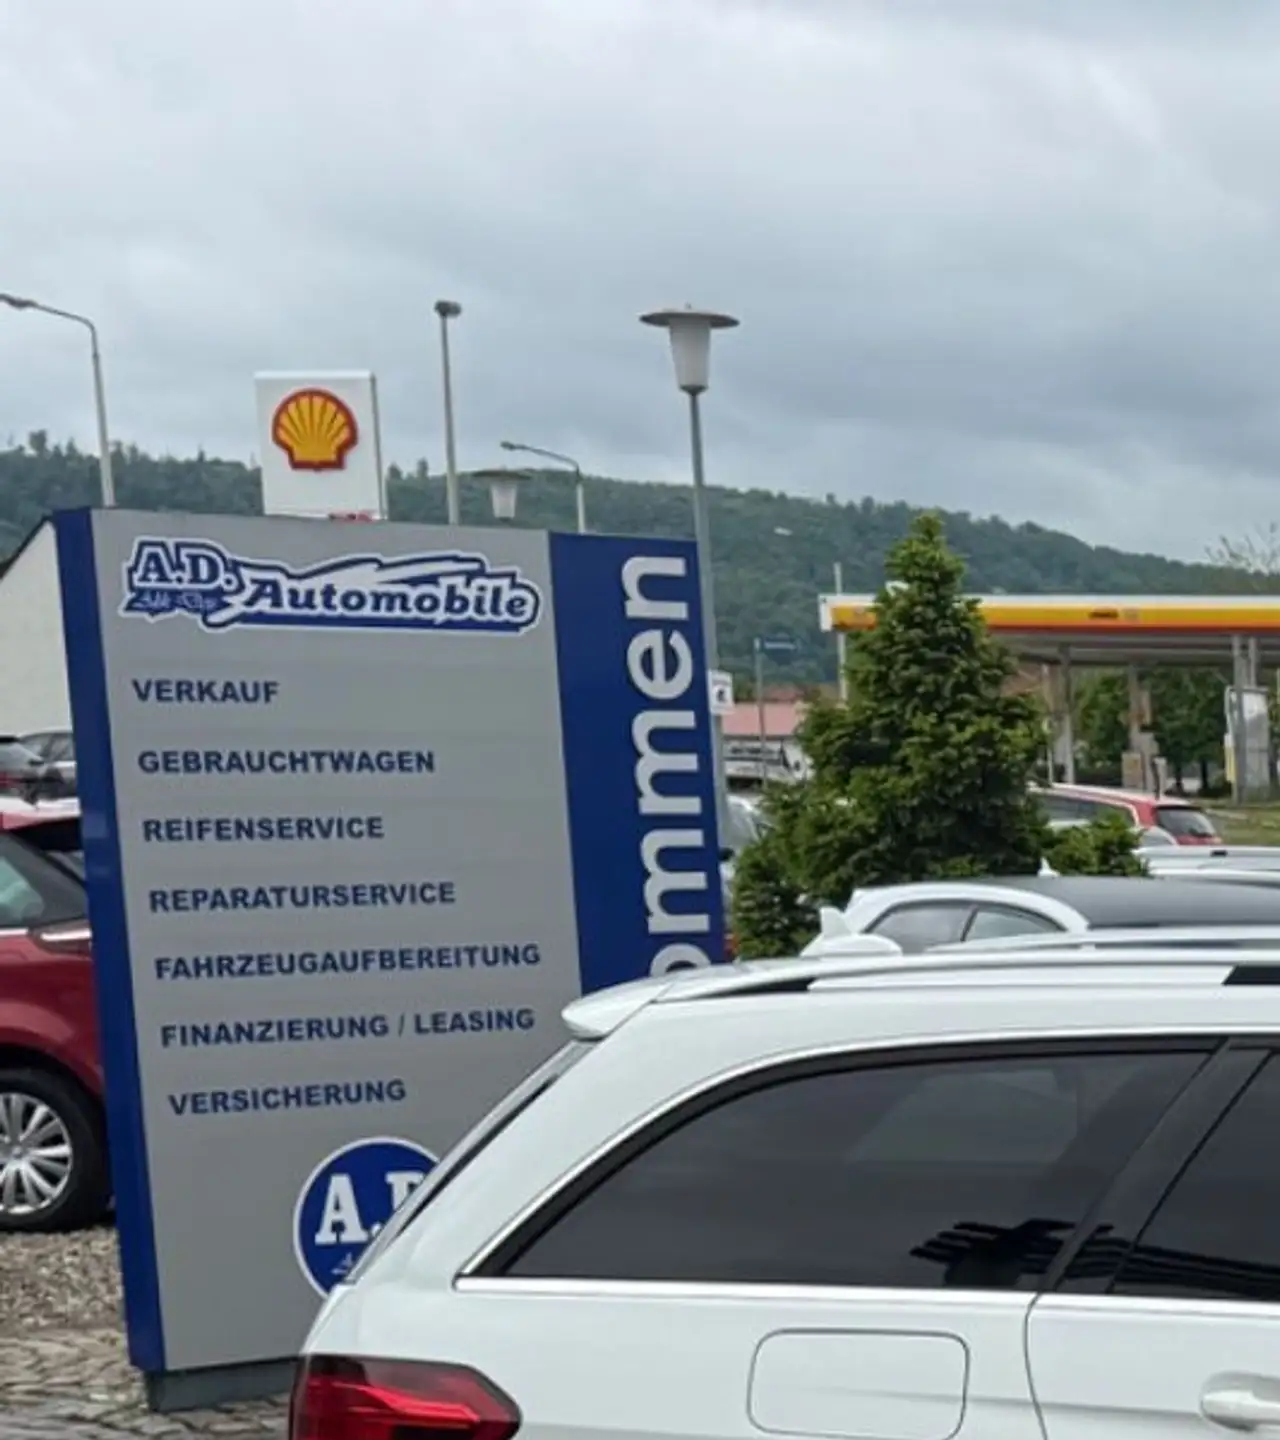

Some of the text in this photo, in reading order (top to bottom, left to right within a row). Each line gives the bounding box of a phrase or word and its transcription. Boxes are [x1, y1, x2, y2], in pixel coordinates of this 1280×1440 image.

[246, 573, 529, 619] Automobile
[132, 679, 279, 703] VERKAUF
[137, 751, 435, 774] GEBRAUCHTWAGEN
[143, 816, 385, 842] REIFENSERVICE
[149, 881, 456, 913] REPARATURSERVICE
[154, 942, 541, 980] FAHRZEUGAUFBEREITUNG
[160, 1015, 389, 1048] FINANZIERUNG
[414, 1007, 535, 1036] LEASING
[168, 1078, 407, 1117] VERSICHERUNG
